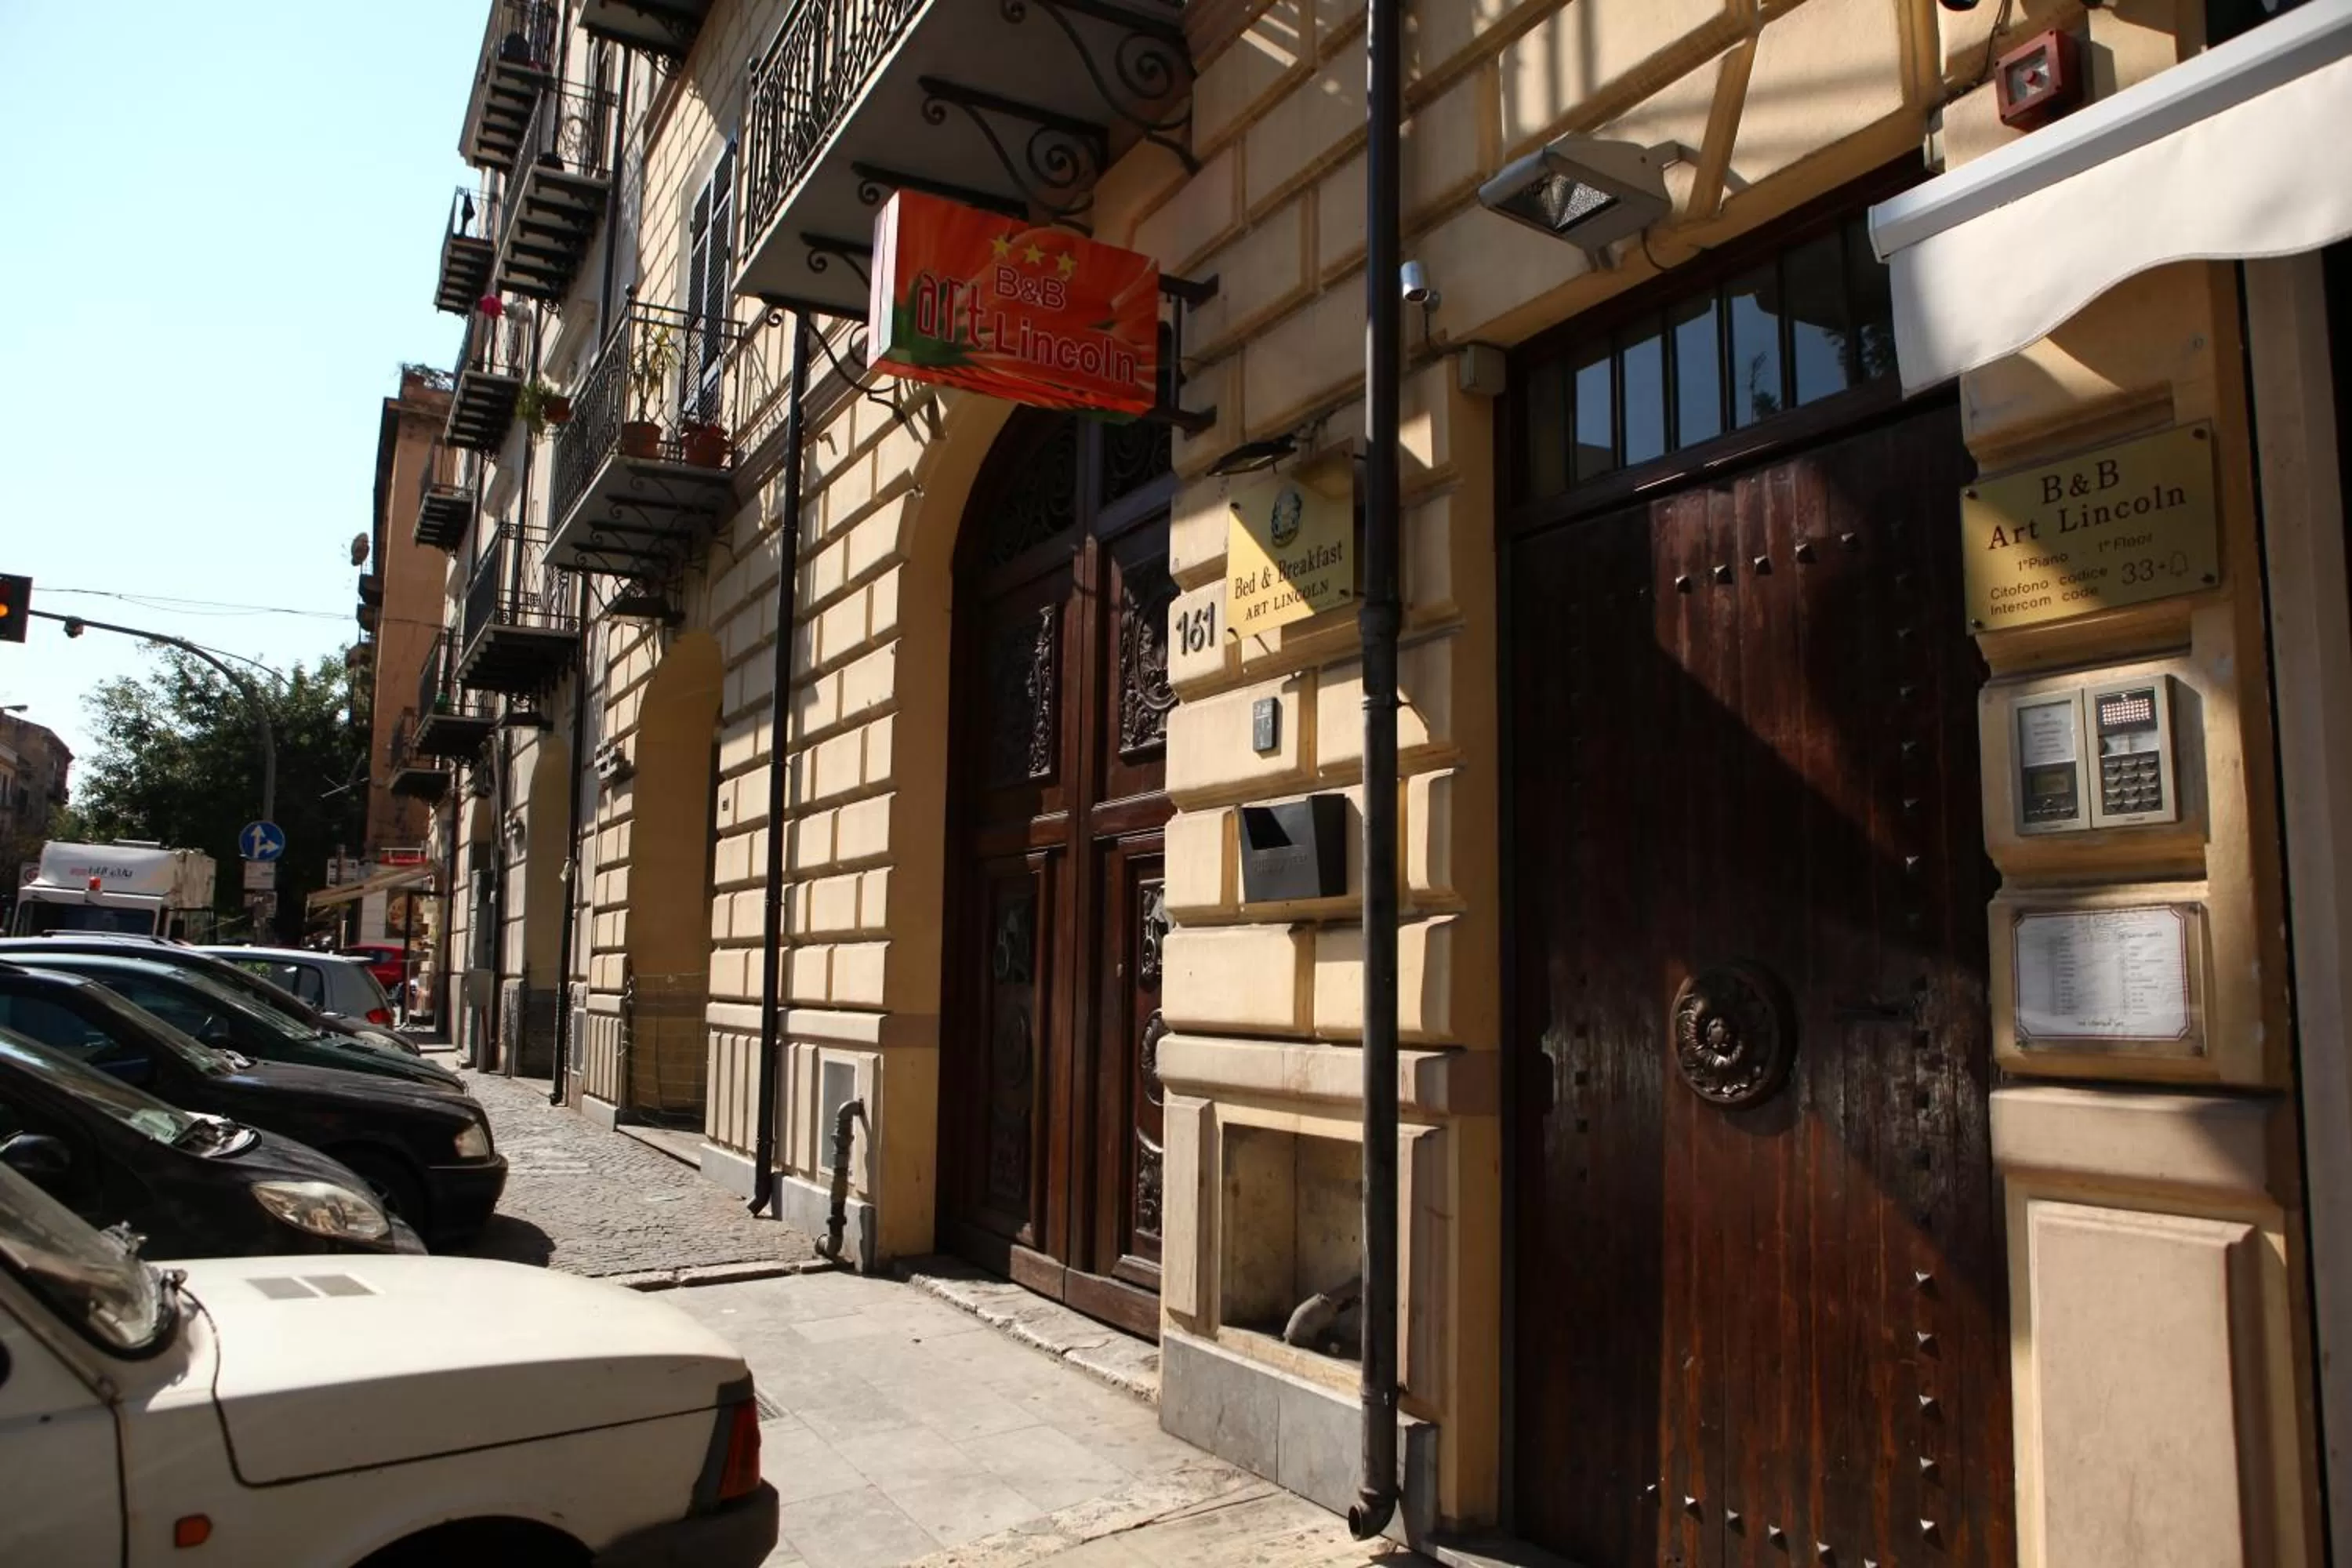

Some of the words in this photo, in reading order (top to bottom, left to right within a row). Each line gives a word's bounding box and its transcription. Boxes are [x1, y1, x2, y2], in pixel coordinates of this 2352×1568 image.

[995, 263, 1065, 310] B&B
[916, 273, 985, 350] art
[993, 312, 1138, 384] Lincoln
[2042, 459, 2119, 505] B&B
[1988, 521, 2038, 550] Art
[2058, 485, 2186, 534] Lincoln
[1235, 572, 1255, 600] Bed
[1261, 565, 1272, 590] &
[1278, 539, 1343, 583] Breakfast
[1990, 579, 2049, 601] Citofono
[2059, 567, 2107, 586] codice
[1245, 601, 1269, 621] ART
[1274, 579, 1329, 611] LINCOLN
[1990, 596, 2052, 615] Intercom
[2062, 587, 2099, 602] code
[1176, 601, 1216, 657] 161
